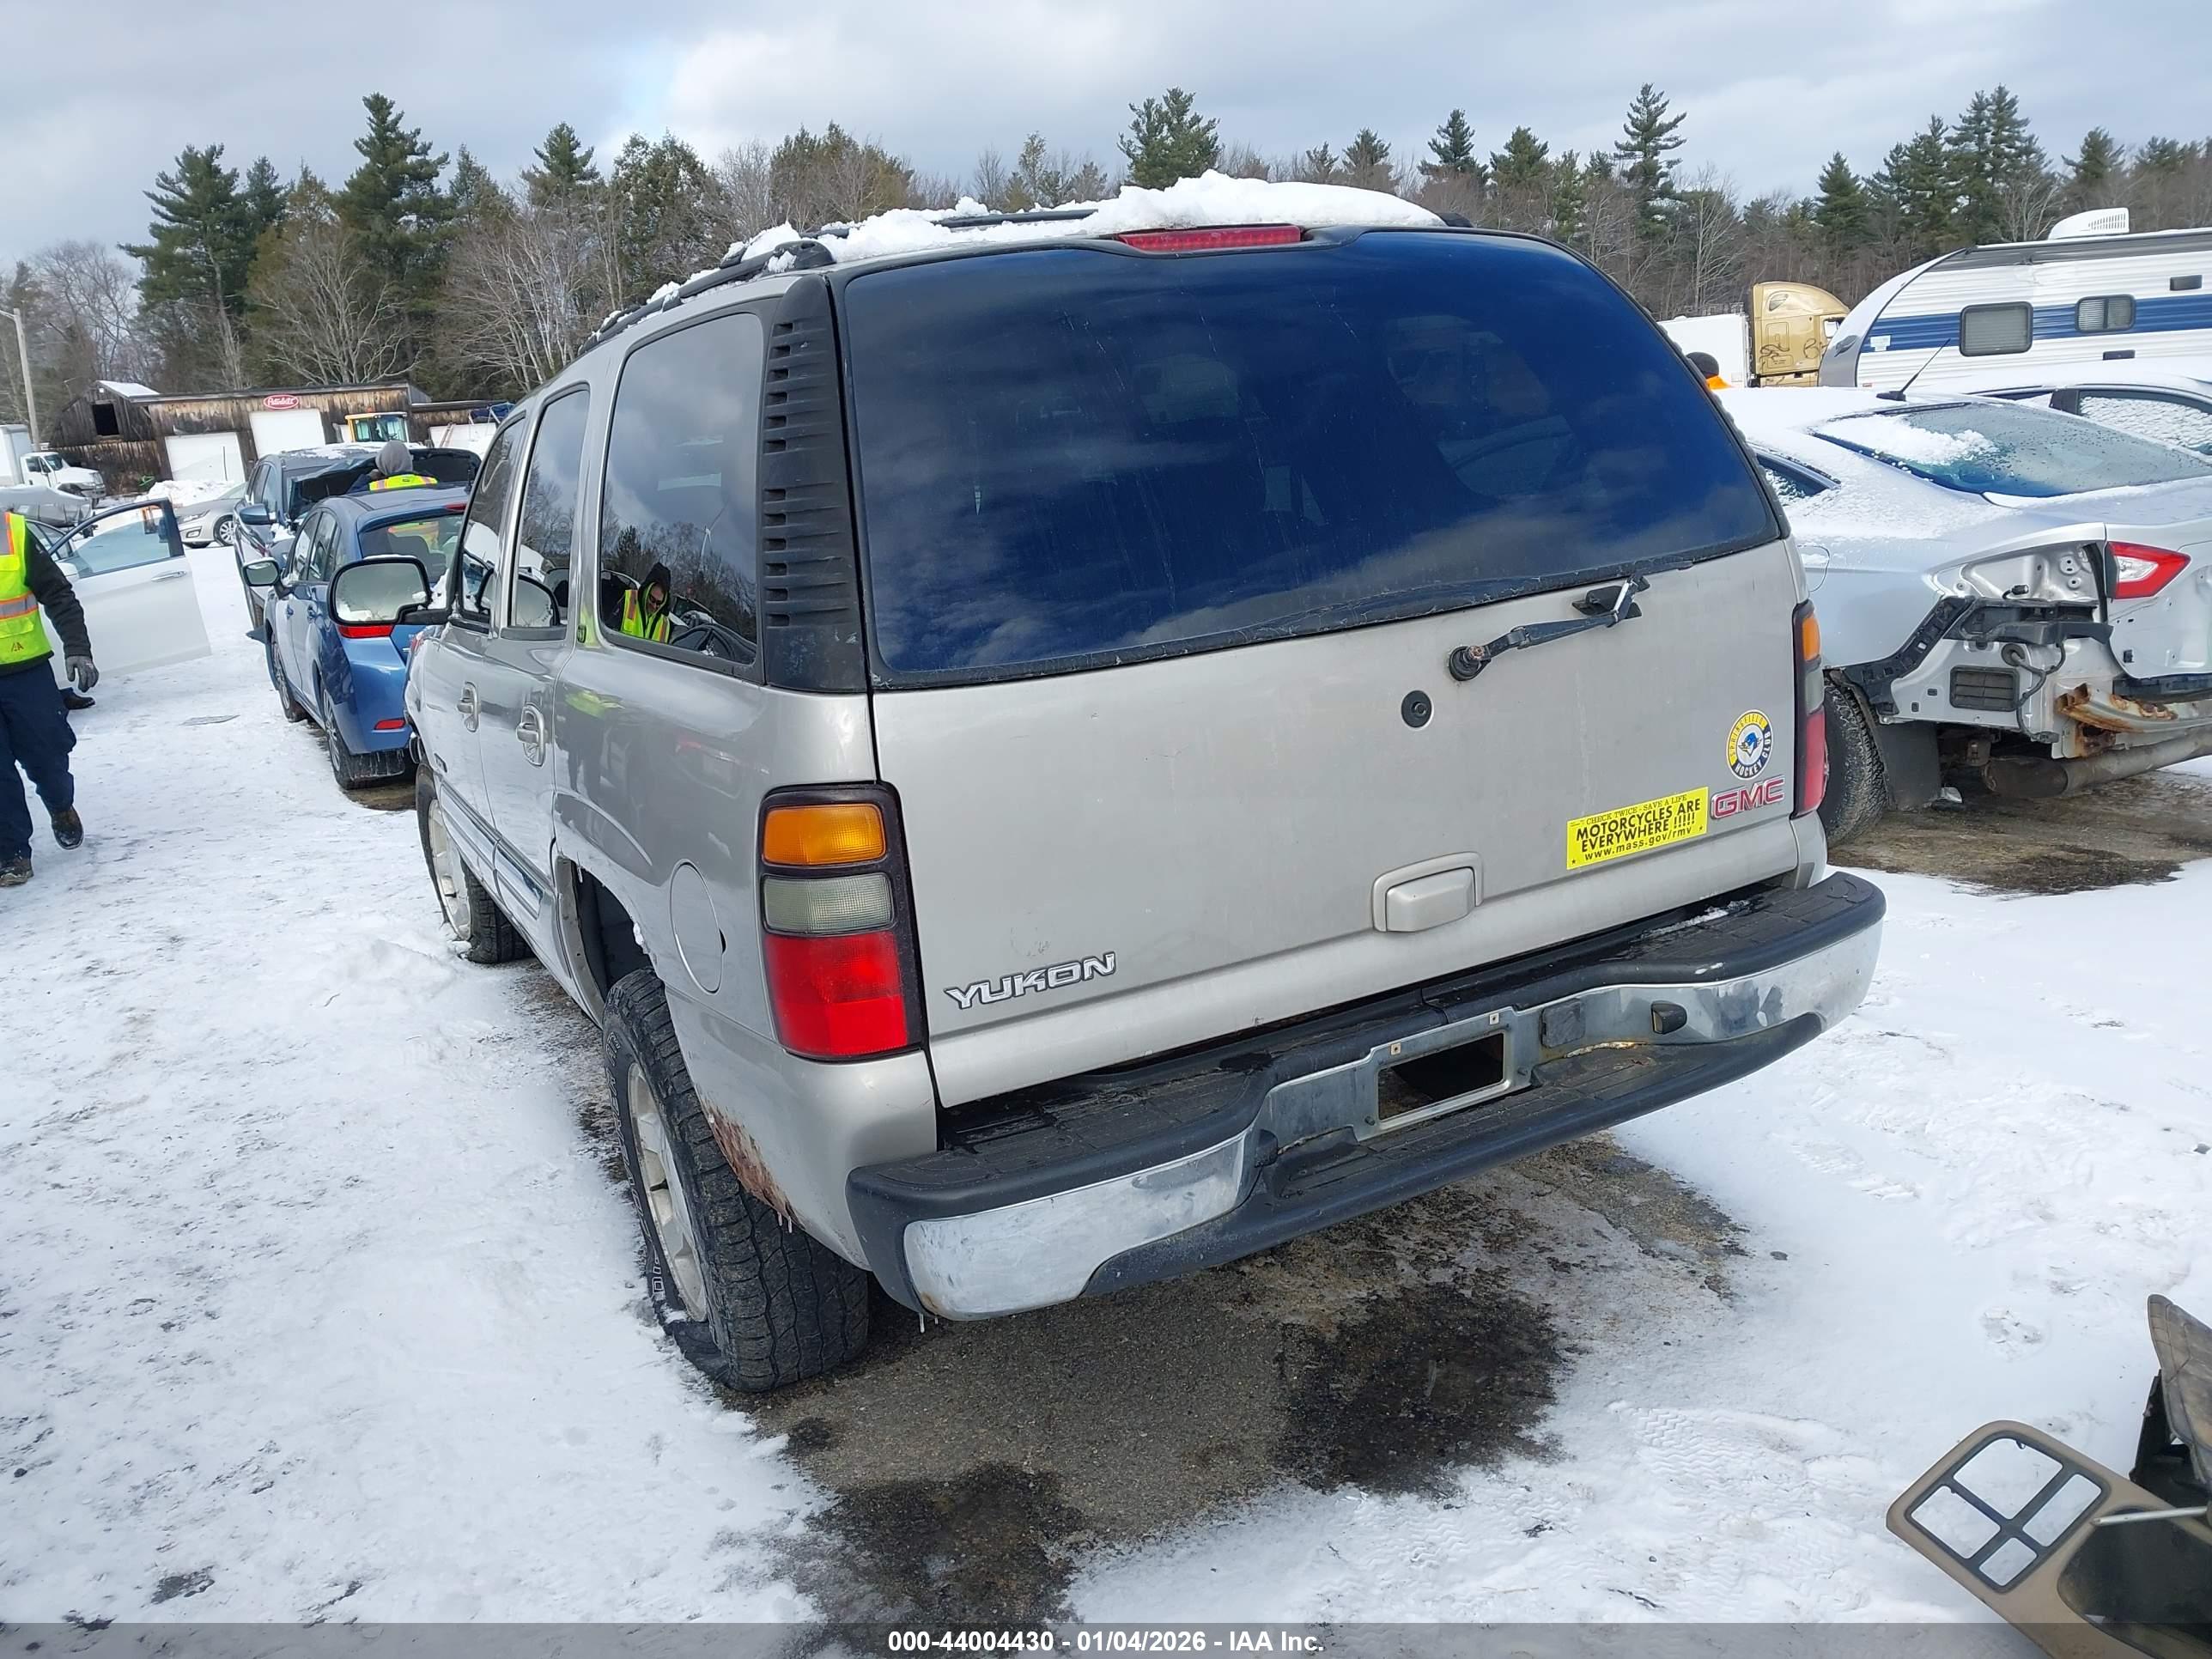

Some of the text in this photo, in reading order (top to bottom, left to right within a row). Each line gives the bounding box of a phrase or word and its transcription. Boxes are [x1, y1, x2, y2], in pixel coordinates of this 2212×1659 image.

[1735, 731, 1771, 777] HOCKEY CLUB
[1586, 812, 1613, 825] CHECK
[1614, 807, 1638, 818] TWICE
[1643, 801, 1664, 811] SAVE
[1671, 794, 1687, 805] LIFE
[1711, 775, 1785, 818] GMC
[1576, 799, 1701, 842] MOTORCYCLES ARE
[1581, 811, 1696, 853] EVERYWHERE !!!!!
[1584, 826, 1692, 861] www.mass.gov/rmv
[944, 951, 1116, 1010] YUKON
